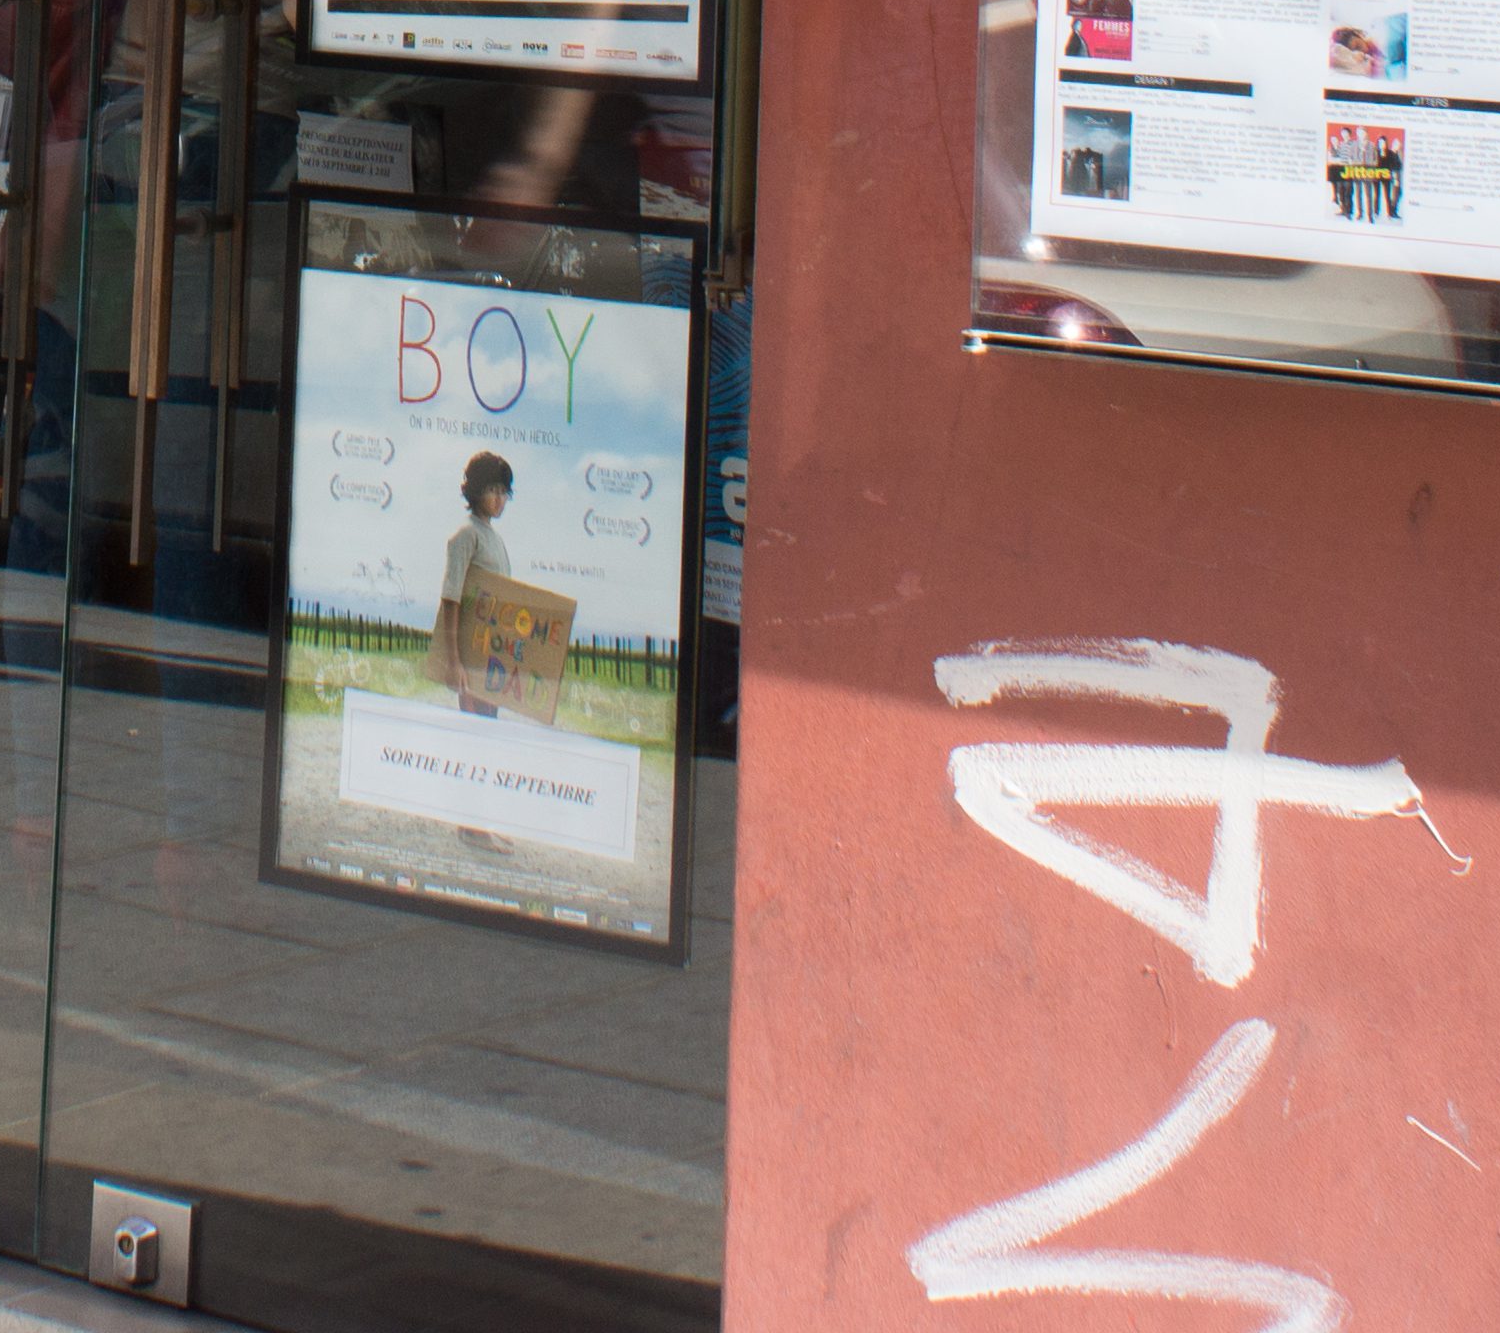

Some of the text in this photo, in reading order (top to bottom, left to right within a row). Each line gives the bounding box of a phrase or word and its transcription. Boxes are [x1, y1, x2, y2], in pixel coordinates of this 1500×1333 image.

[522, 41, 549, 52] nova
[398, 293, 595, 424] BOY
[409, 414, 527, 443] ON TOUS BESOIN D'UN
[380, 744, 596, 807] SORTIE LE 12 SEPTEMBRE
